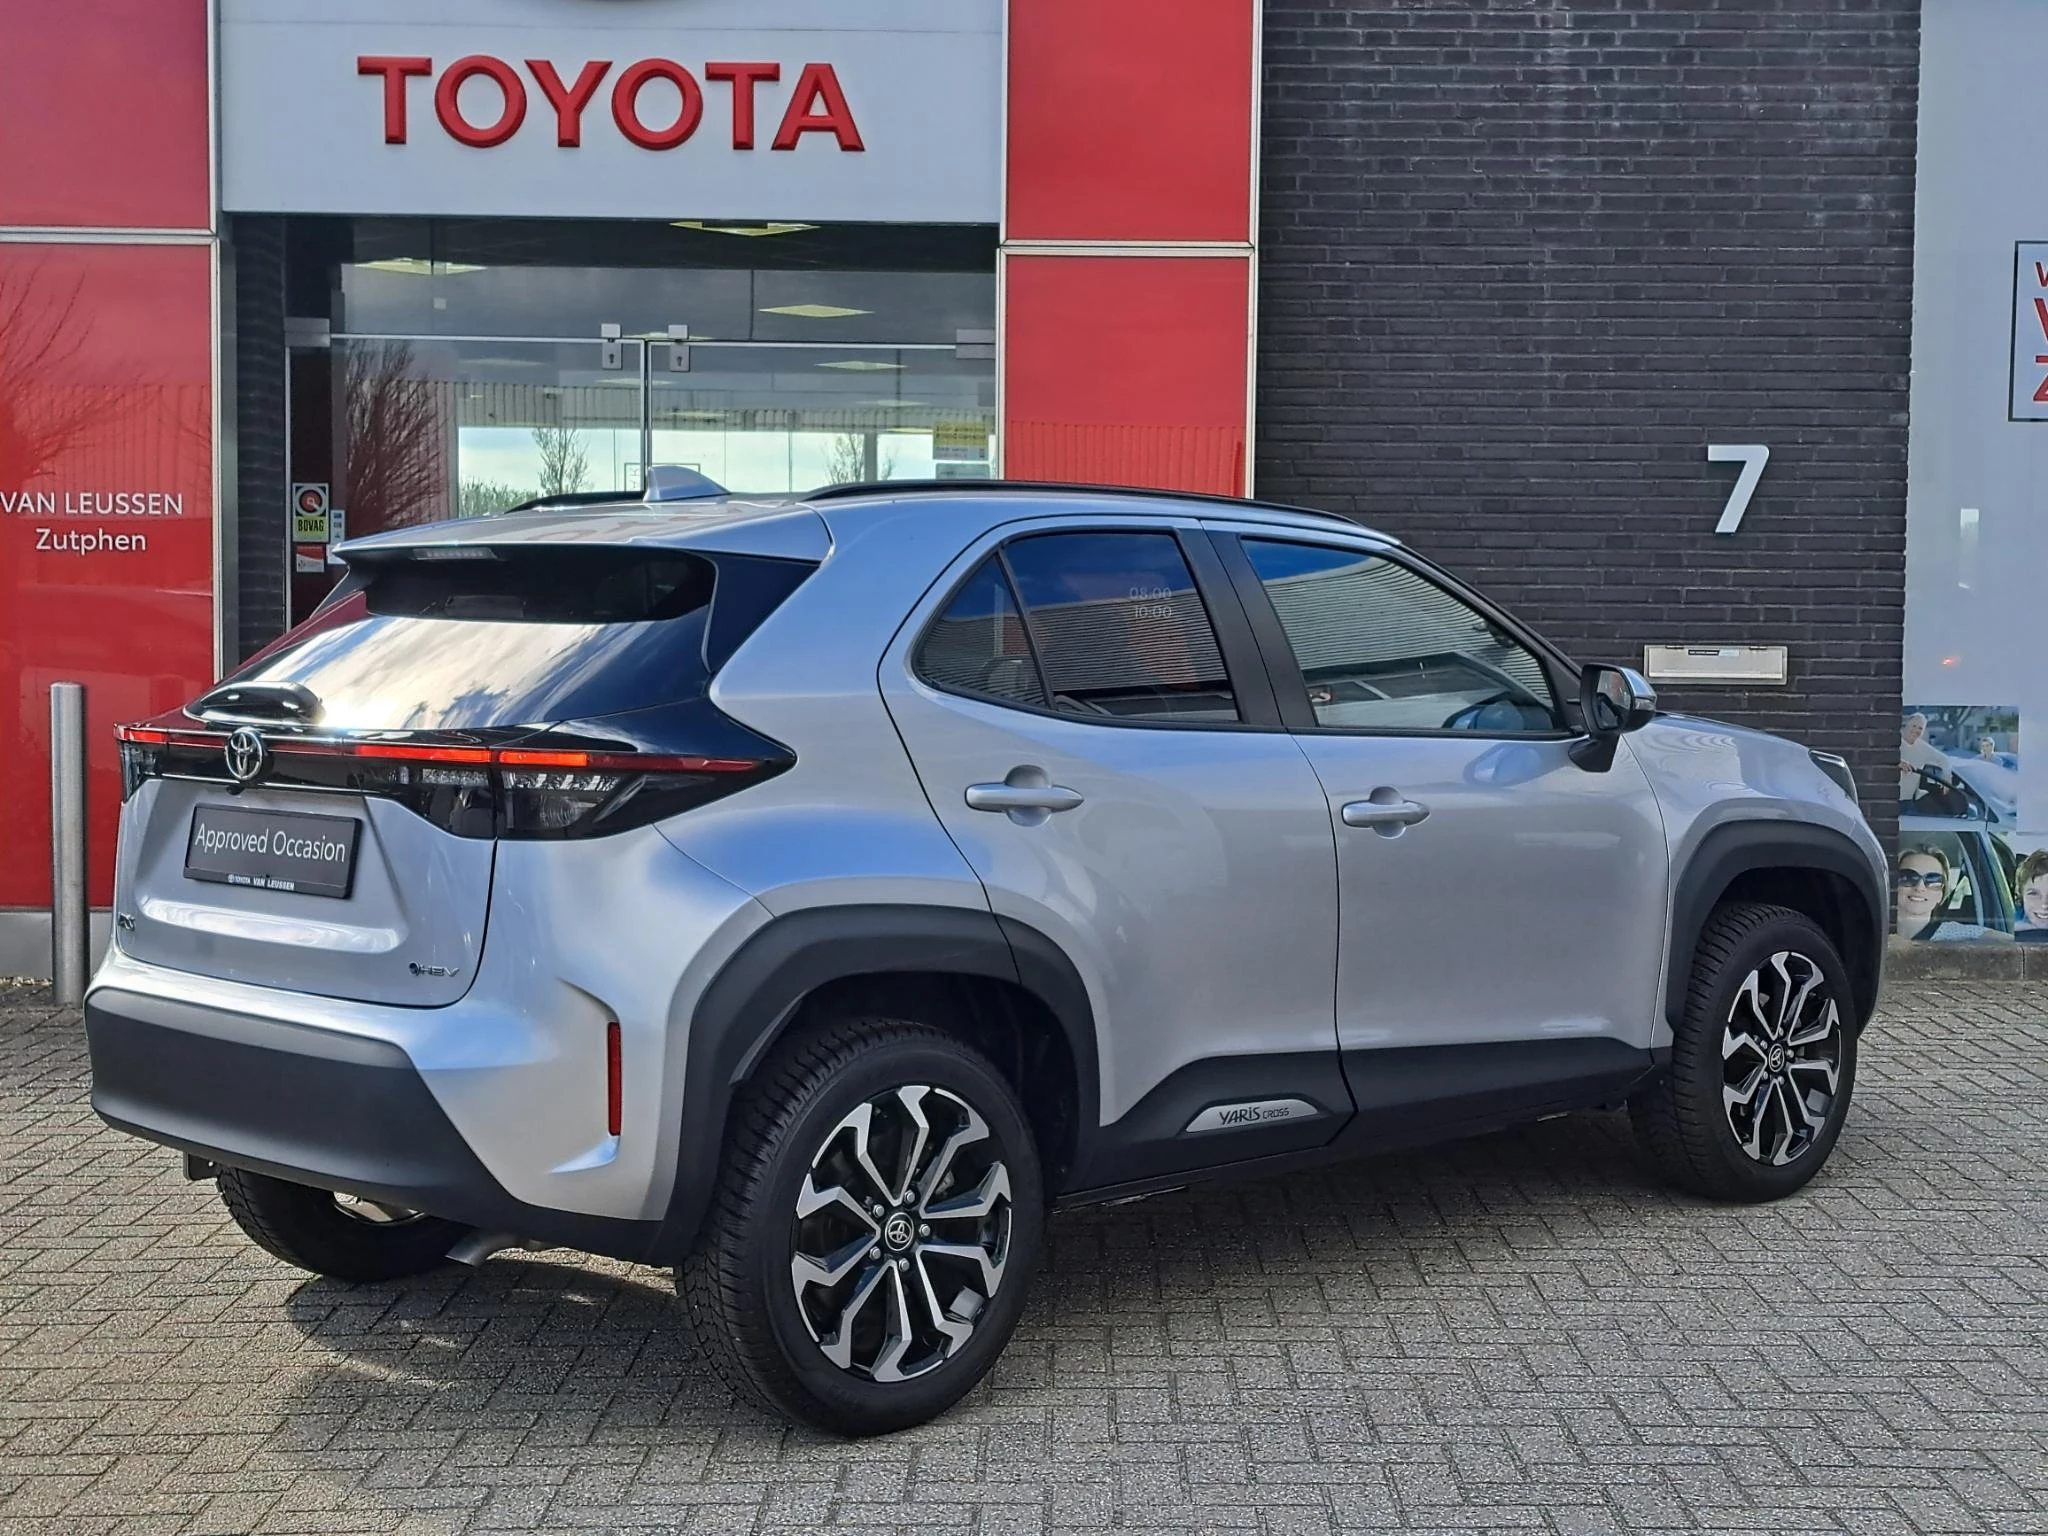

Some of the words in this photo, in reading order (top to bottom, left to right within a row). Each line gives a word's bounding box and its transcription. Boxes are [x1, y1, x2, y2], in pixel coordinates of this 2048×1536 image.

[357, 54, 866, 152] TOYOTA
[1707, 444, 1770, 534] 7
[0, 491, 56, 514] VAN
[65, 492, 184, 515] LEUSSEN
[297, 518, 325, 532] BOVAG
[36, 527, 147, 556] Zutphen
[194, 822, 270, 854] Approved
[273, 830, 346, 863] Occasion
[234, 875, 251, 884] TOYOTA
[253, 877, 266, 887] VAN
[267, 879, 295, 891] LEUSSEN
[1262, 1107, 1290, 1120] CROSS
